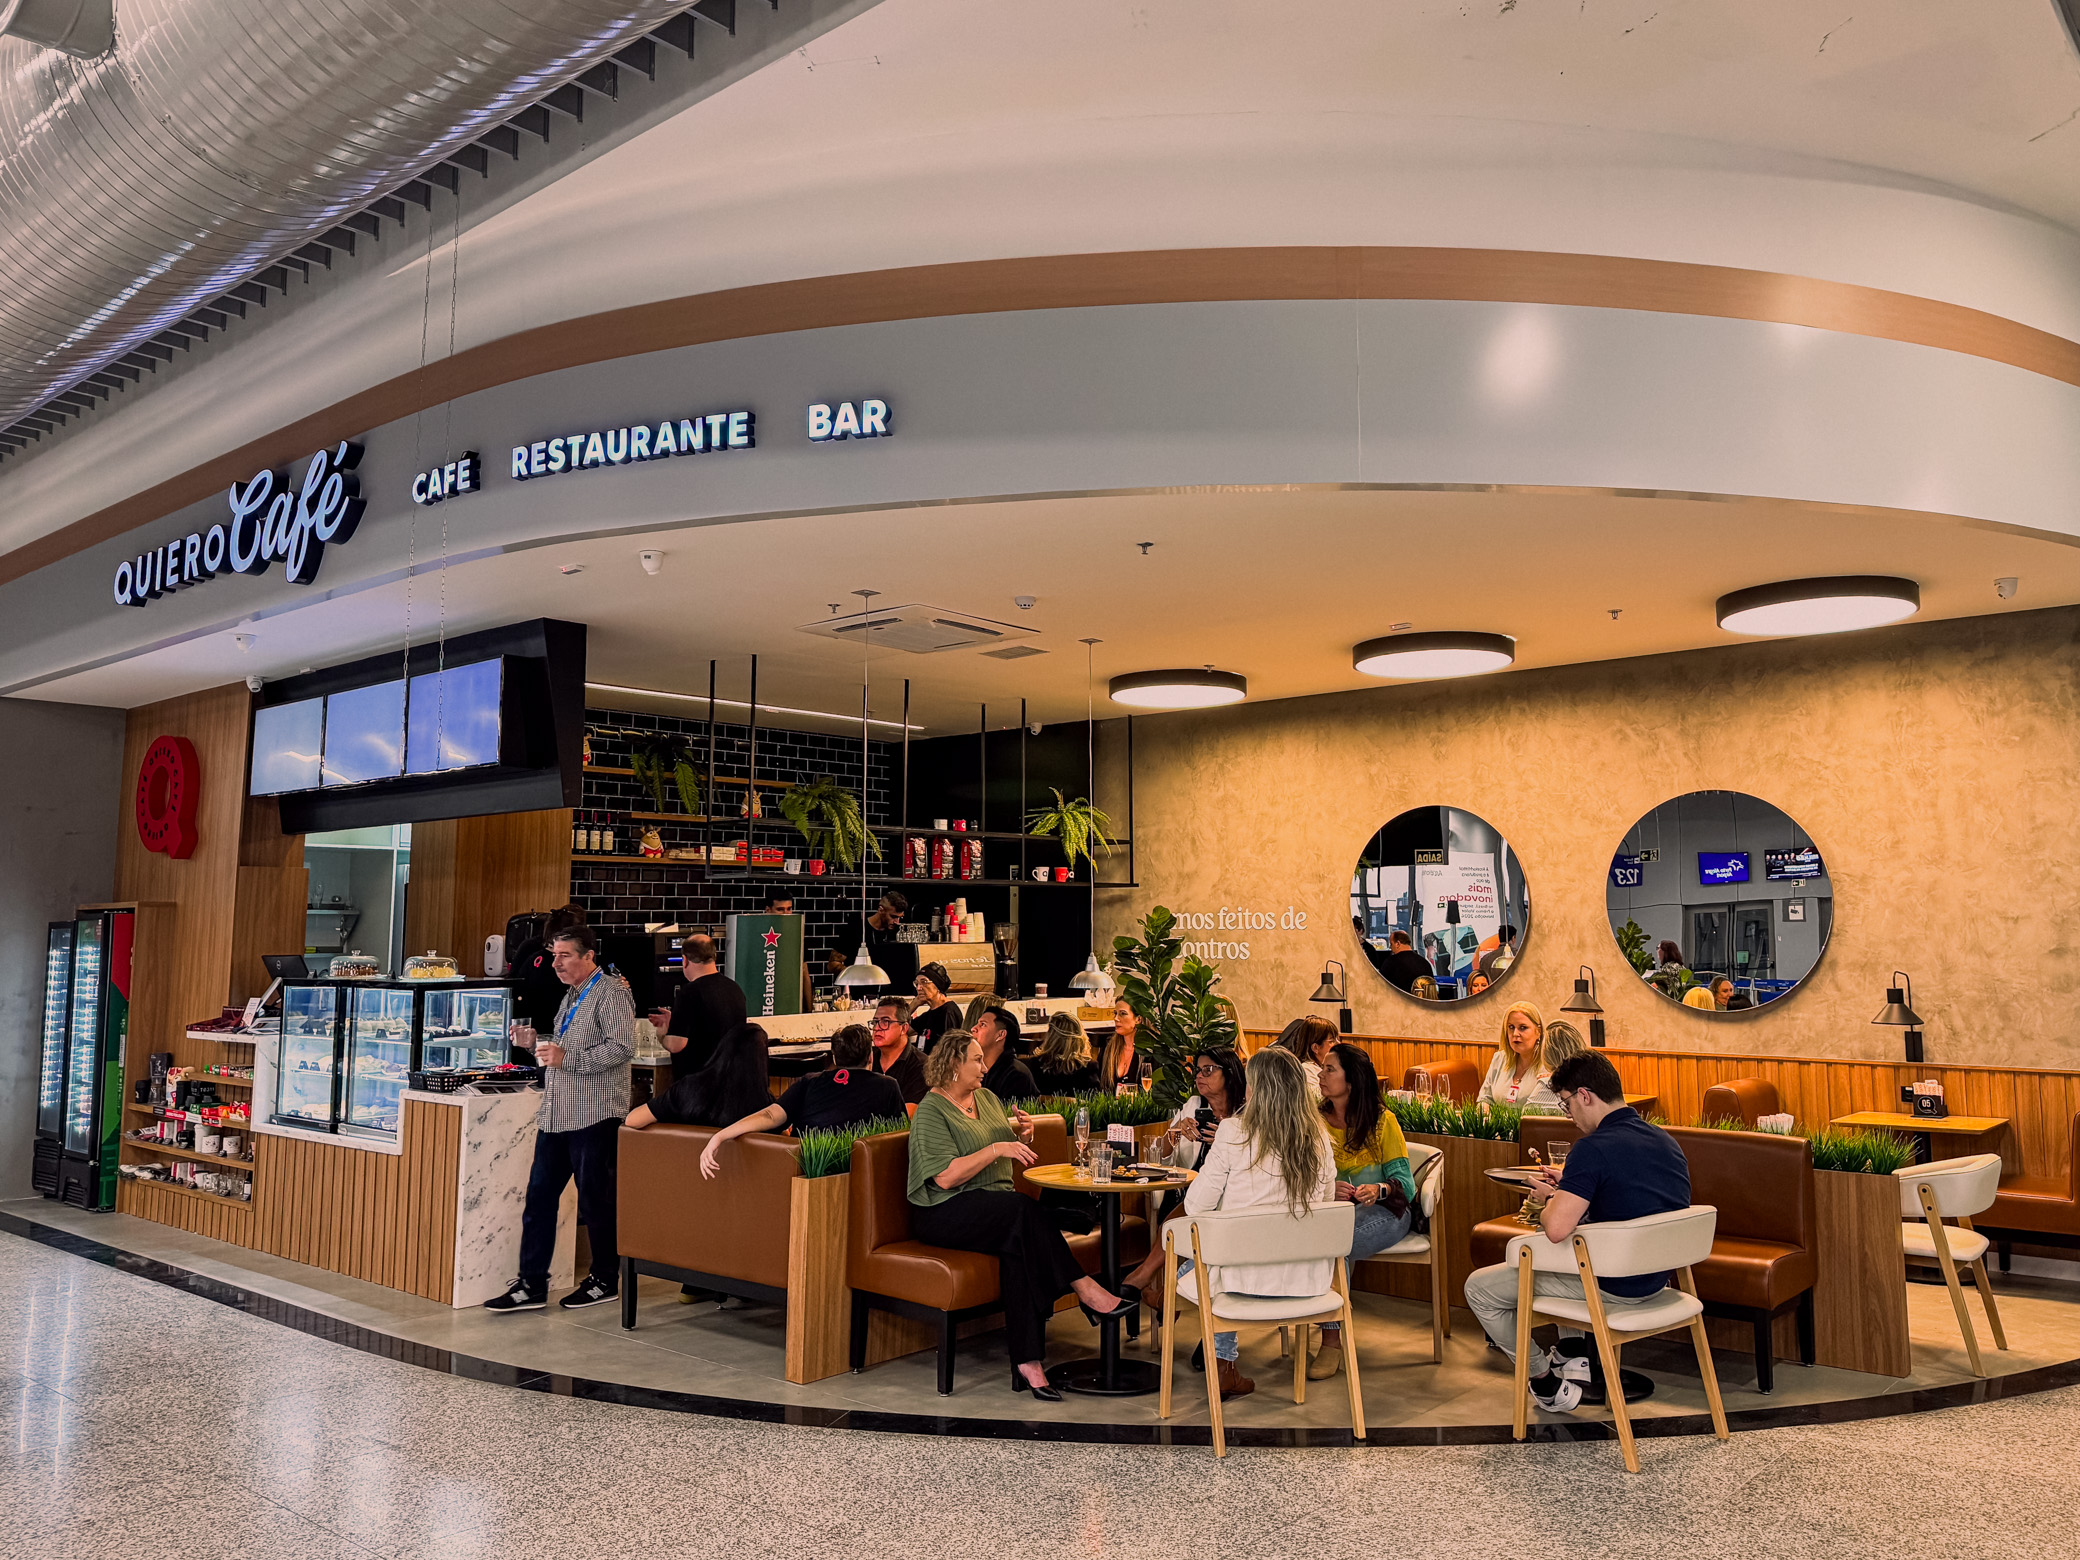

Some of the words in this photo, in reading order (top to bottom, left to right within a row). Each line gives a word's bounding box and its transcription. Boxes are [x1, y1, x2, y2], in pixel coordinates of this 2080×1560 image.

[412, 451, 471, 503] CAFÉ
[511, 411, 749, 479] RESTAURANTE
[807, 399, 888, 439] BAR
[113, 524, 225, 605] QUIERO
[229, 440, 351, 583] Café
[1217, 906, 1276, 930] feitos
[1280, 906, 1308, 930] de
[1176, 938, 1250, 960] ontros
[762, 950, 776, 1016] Heineken
[1922, 1099, 1931, 1108] 05
